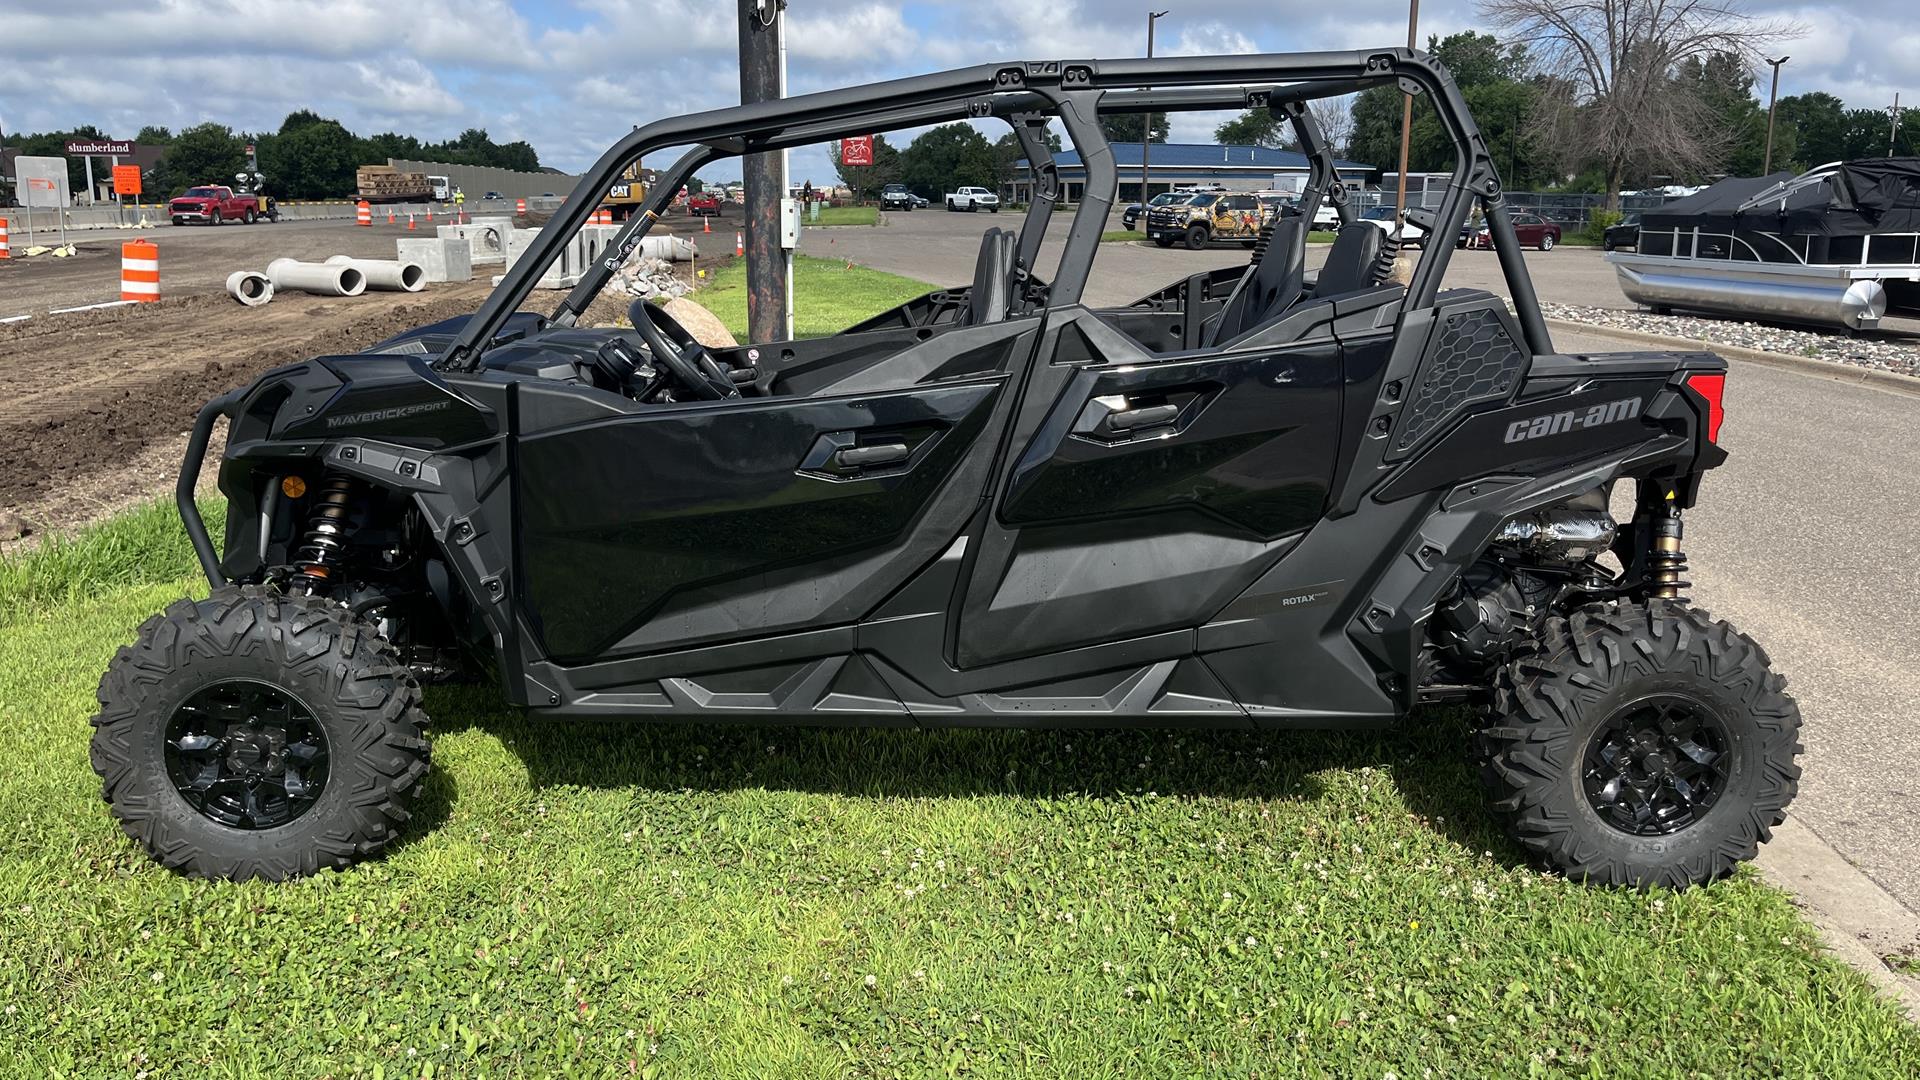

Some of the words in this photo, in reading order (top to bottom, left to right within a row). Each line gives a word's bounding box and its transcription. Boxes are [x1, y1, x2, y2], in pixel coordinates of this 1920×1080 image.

[68, 142, 129, 153] slumberland
[610, 185, 629, 198] CAT
[1504, 397, 1642, 443] can-am
[1282, 593, 1315, 606] ROTAX
